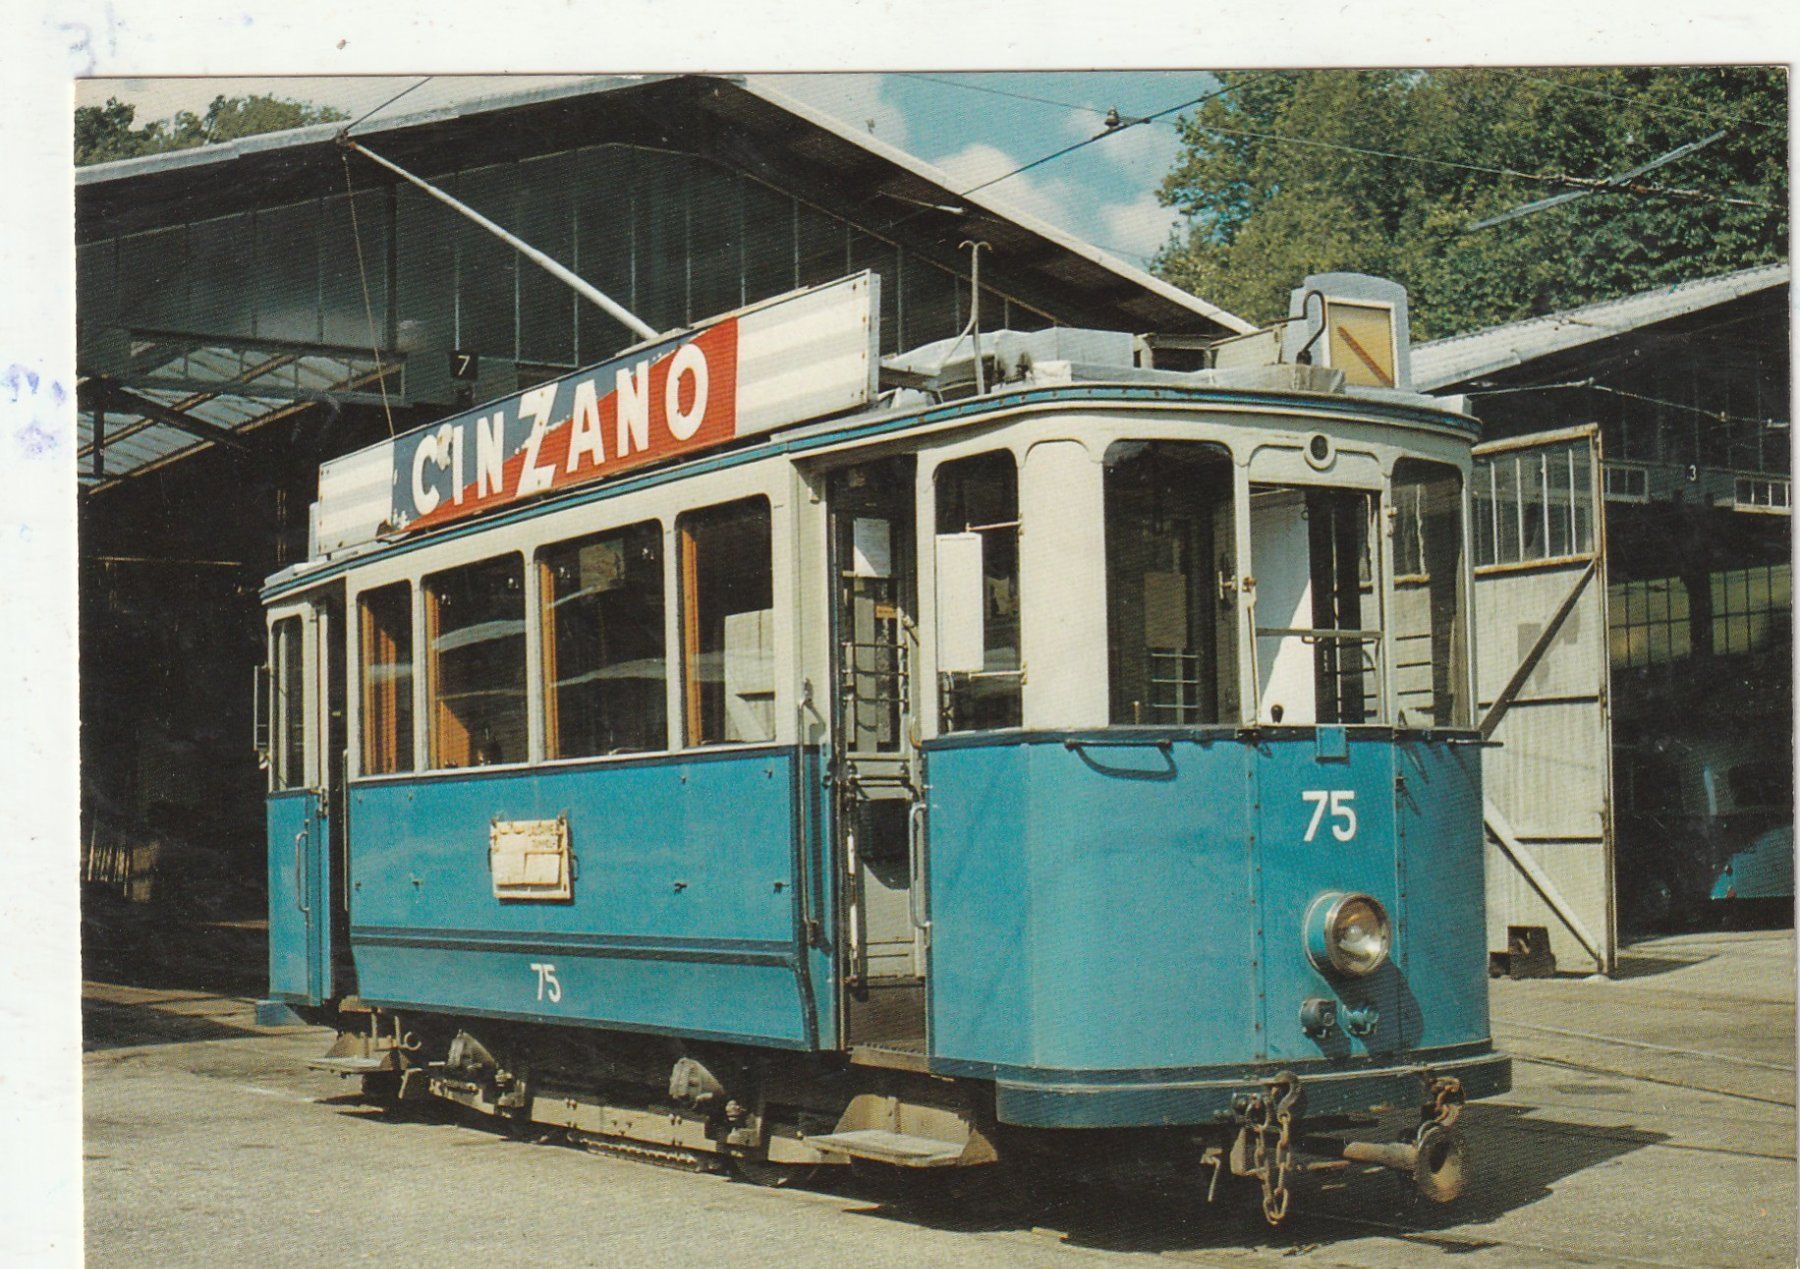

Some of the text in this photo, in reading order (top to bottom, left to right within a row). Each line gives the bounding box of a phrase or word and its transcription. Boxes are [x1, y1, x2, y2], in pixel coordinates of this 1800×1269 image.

[458, 354, 471, 376] 7
[411, 343, 709, 515] CINZANO
[1302, 790, 1357, 842] 75
[530, 963, 561, 1003] 75
